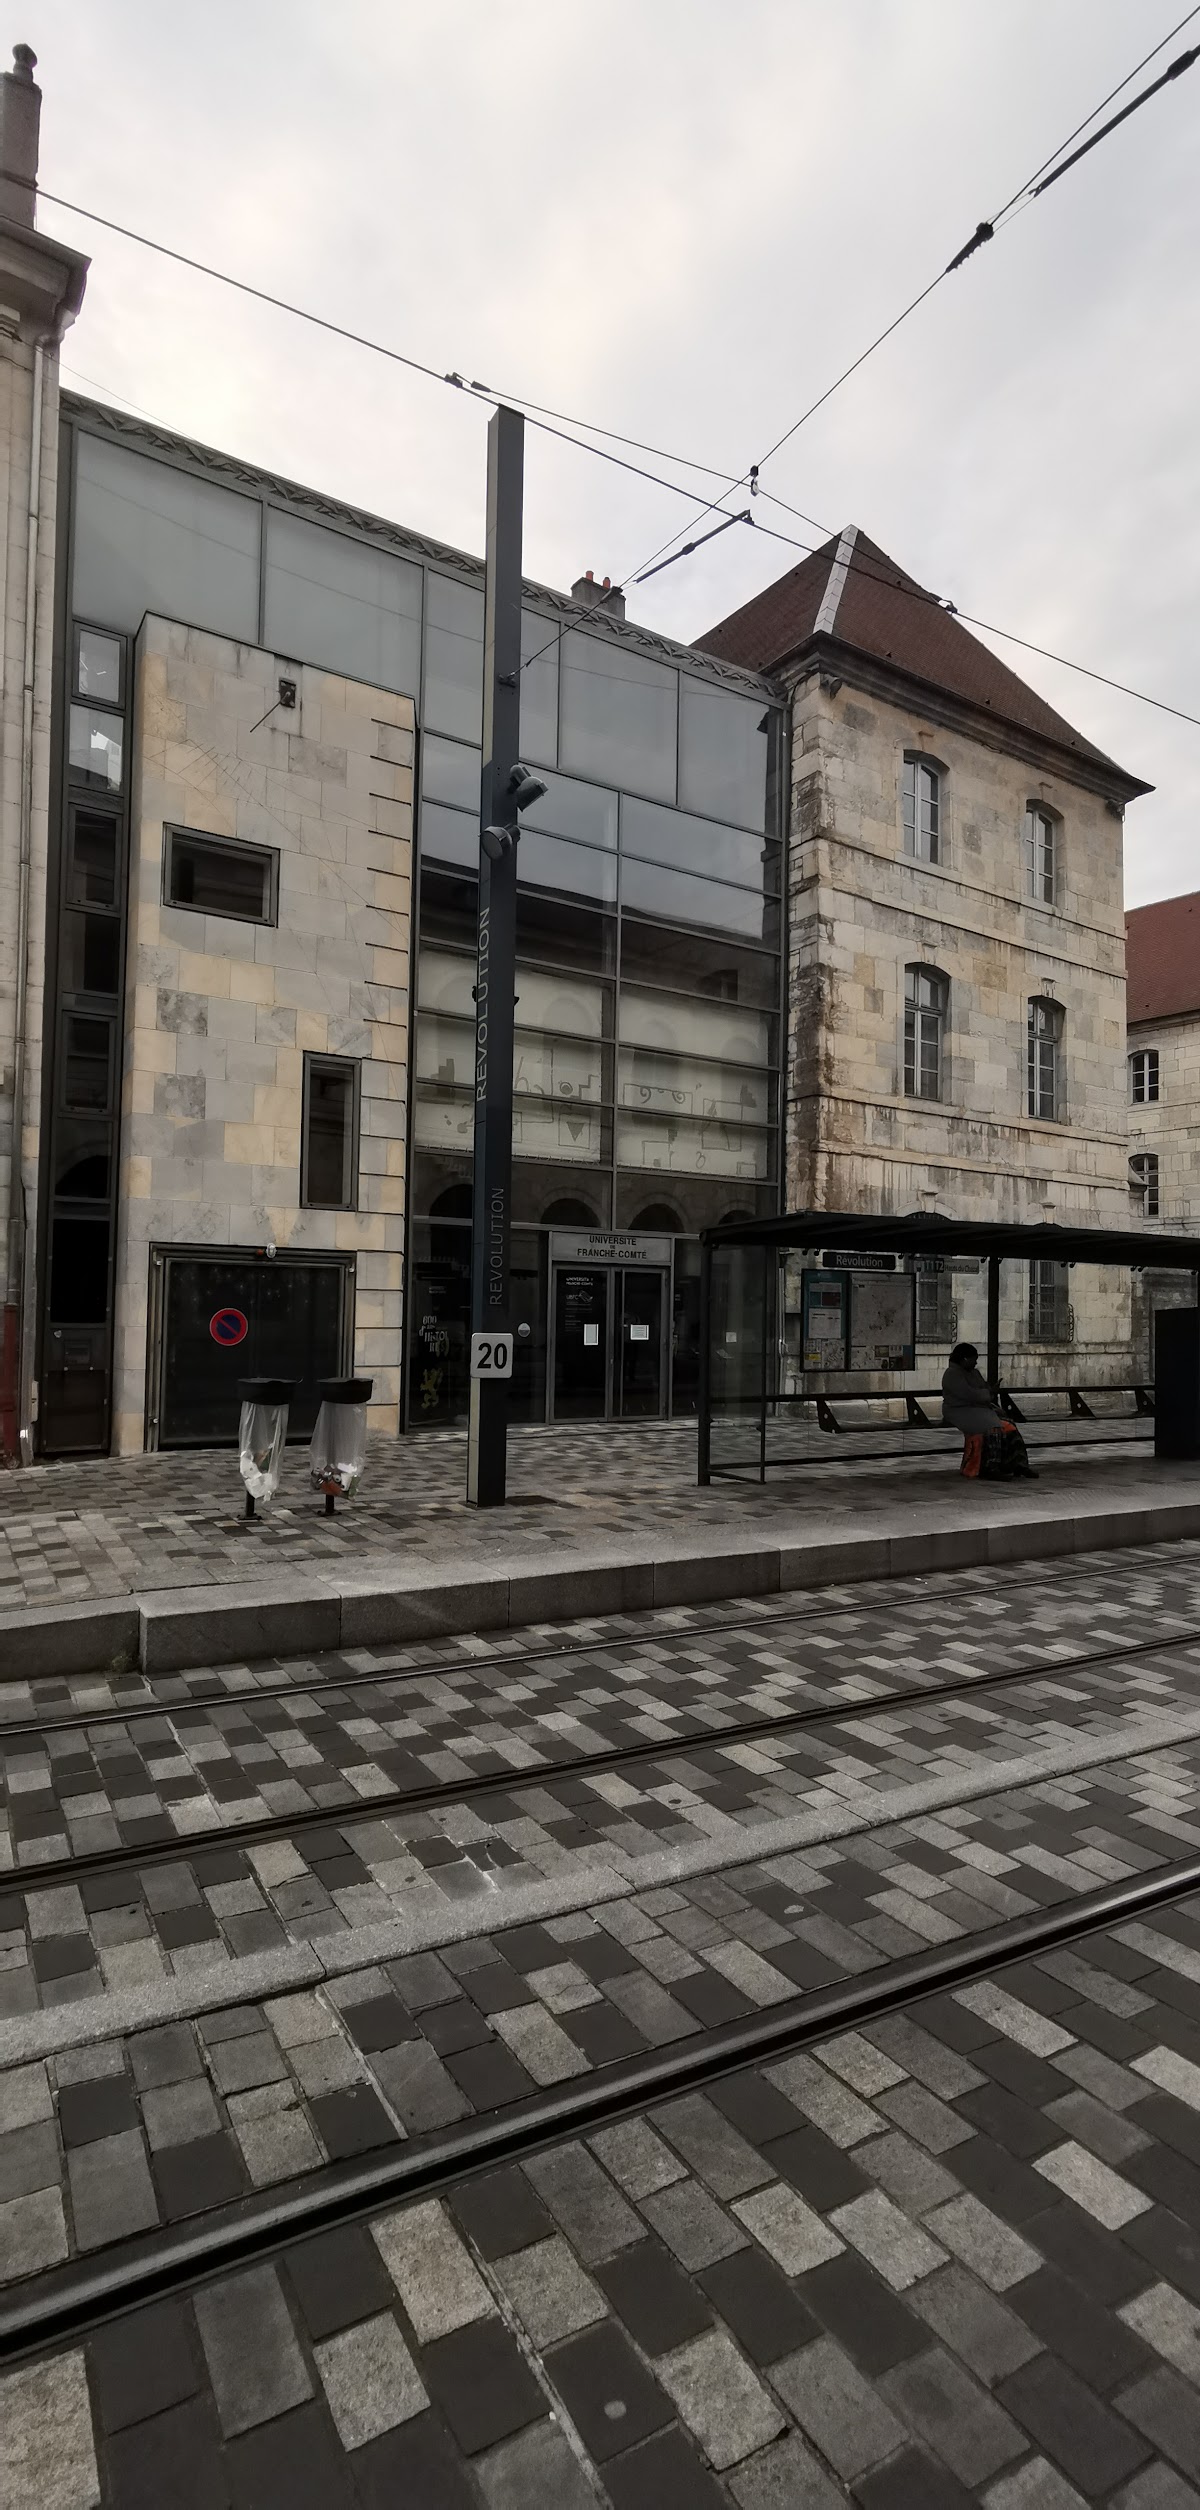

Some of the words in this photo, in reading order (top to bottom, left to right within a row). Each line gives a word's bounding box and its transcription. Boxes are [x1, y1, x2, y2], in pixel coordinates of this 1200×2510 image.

[476, 906, 490, 1102] REVOLUTION
[489, 1187, 504, 1305] REVOLUTION
[836, 1255, 884, 1268] Révolution
[935, 1261, 944, 1271] T2
[476, 1342, 508, 1369] 20
